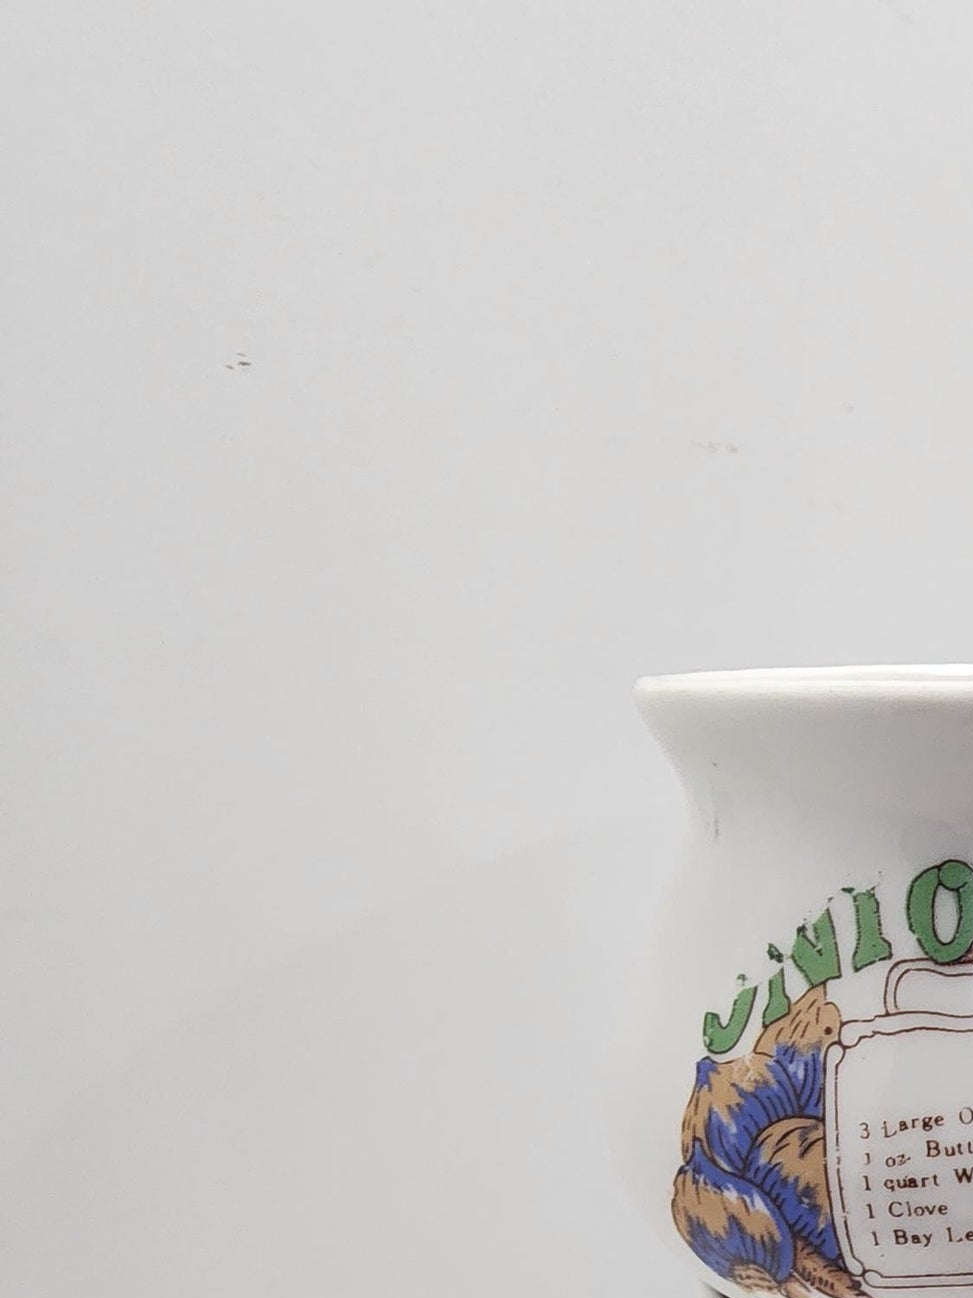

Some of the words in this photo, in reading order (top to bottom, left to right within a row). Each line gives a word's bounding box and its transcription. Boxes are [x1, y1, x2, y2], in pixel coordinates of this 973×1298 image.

[859, 1122, 871, 1140] 3
[883, 1114, 945, 1139] Large
[863, 1152, 872, 1166] 1
[862, 1175, 872, 1192] 1
[883, 1173, 941, 1193] quart
[865, 1202, 876, 1220] 1
[887, 1200, 949, 1219] Clove
[871, 1231, 880, 1247] 1
[893, 1228, 933, 1248] Bay
